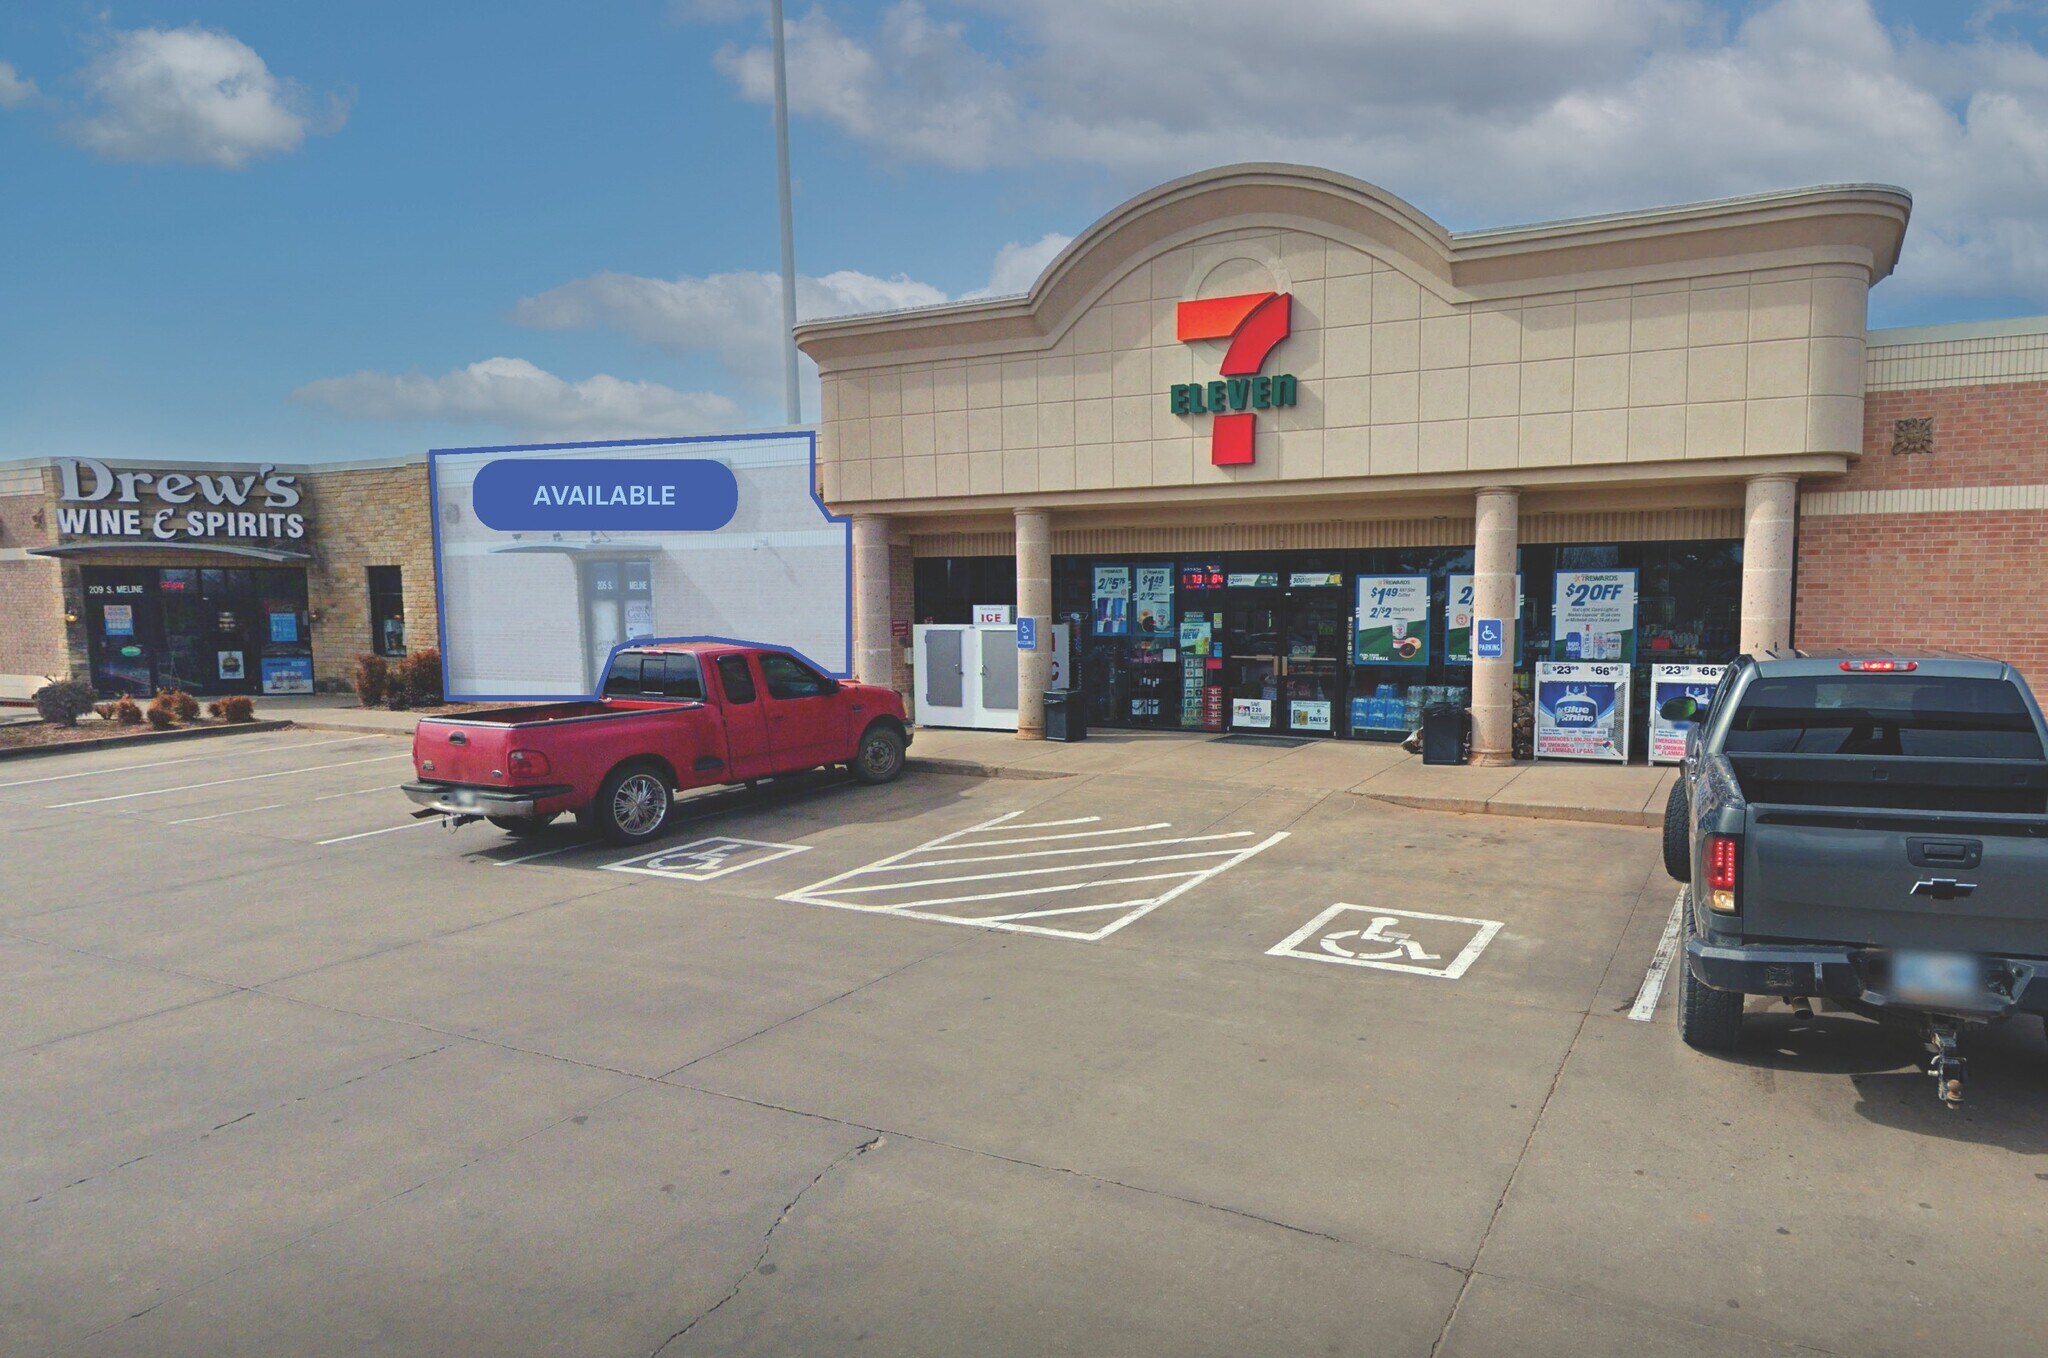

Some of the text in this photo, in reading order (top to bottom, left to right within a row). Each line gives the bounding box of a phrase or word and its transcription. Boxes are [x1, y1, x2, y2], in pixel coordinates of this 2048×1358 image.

[1177, 291, 1292, 466] 7
[53, 457, 300, 507] Drew's
[57, 508, 304, 539] WINE & SPIRITS
[1370, 587, 1399, 605] $149
[981, 614, 1001, 623] ICE
[1182, 631, 1200, 640] NEW
[1478, 643, 1501, 652] PARKING
[1563, 705, 1590, 714] Blue
